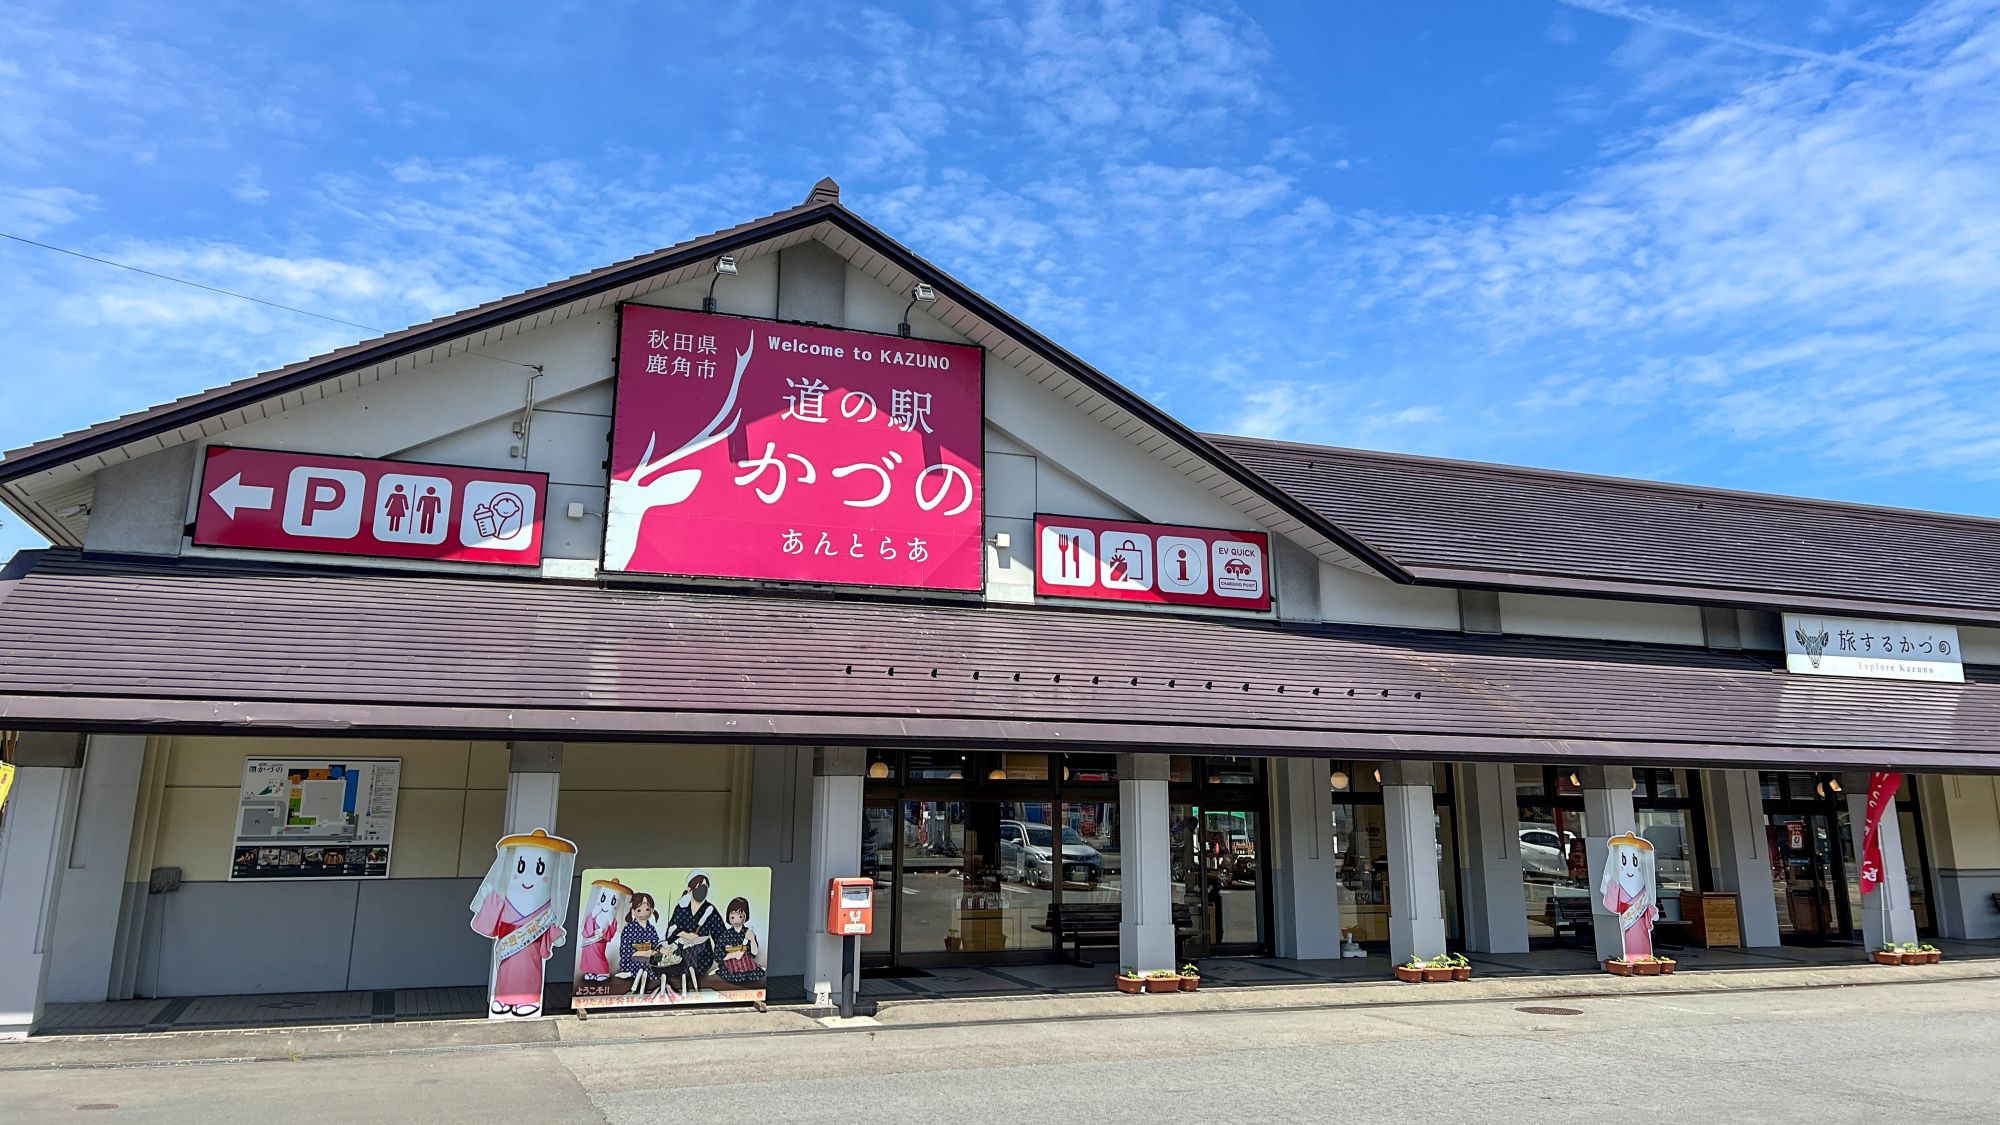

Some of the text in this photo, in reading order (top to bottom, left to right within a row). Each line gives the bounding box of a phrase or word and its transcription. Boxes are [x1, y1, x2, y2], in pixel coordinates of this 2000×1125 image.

[647, 329, 718, 355] 秋田県
[768, 335, 950, 371] Welcome to KAZUNO
[645, 353, 717, 379] 鹿角市
[781, 376, 934, 434] 道の駅
[734, 441, 973, 516] かづの
[301, 477, 346, 527] P
[781, 529, 929, 563] あんとらあ
[1218, 547, 1255, 557] EV QUICK
[1837, 629, 1952, 656] 旅するかづの
[1858, 661, 1935, 674] Explore Kazuno
